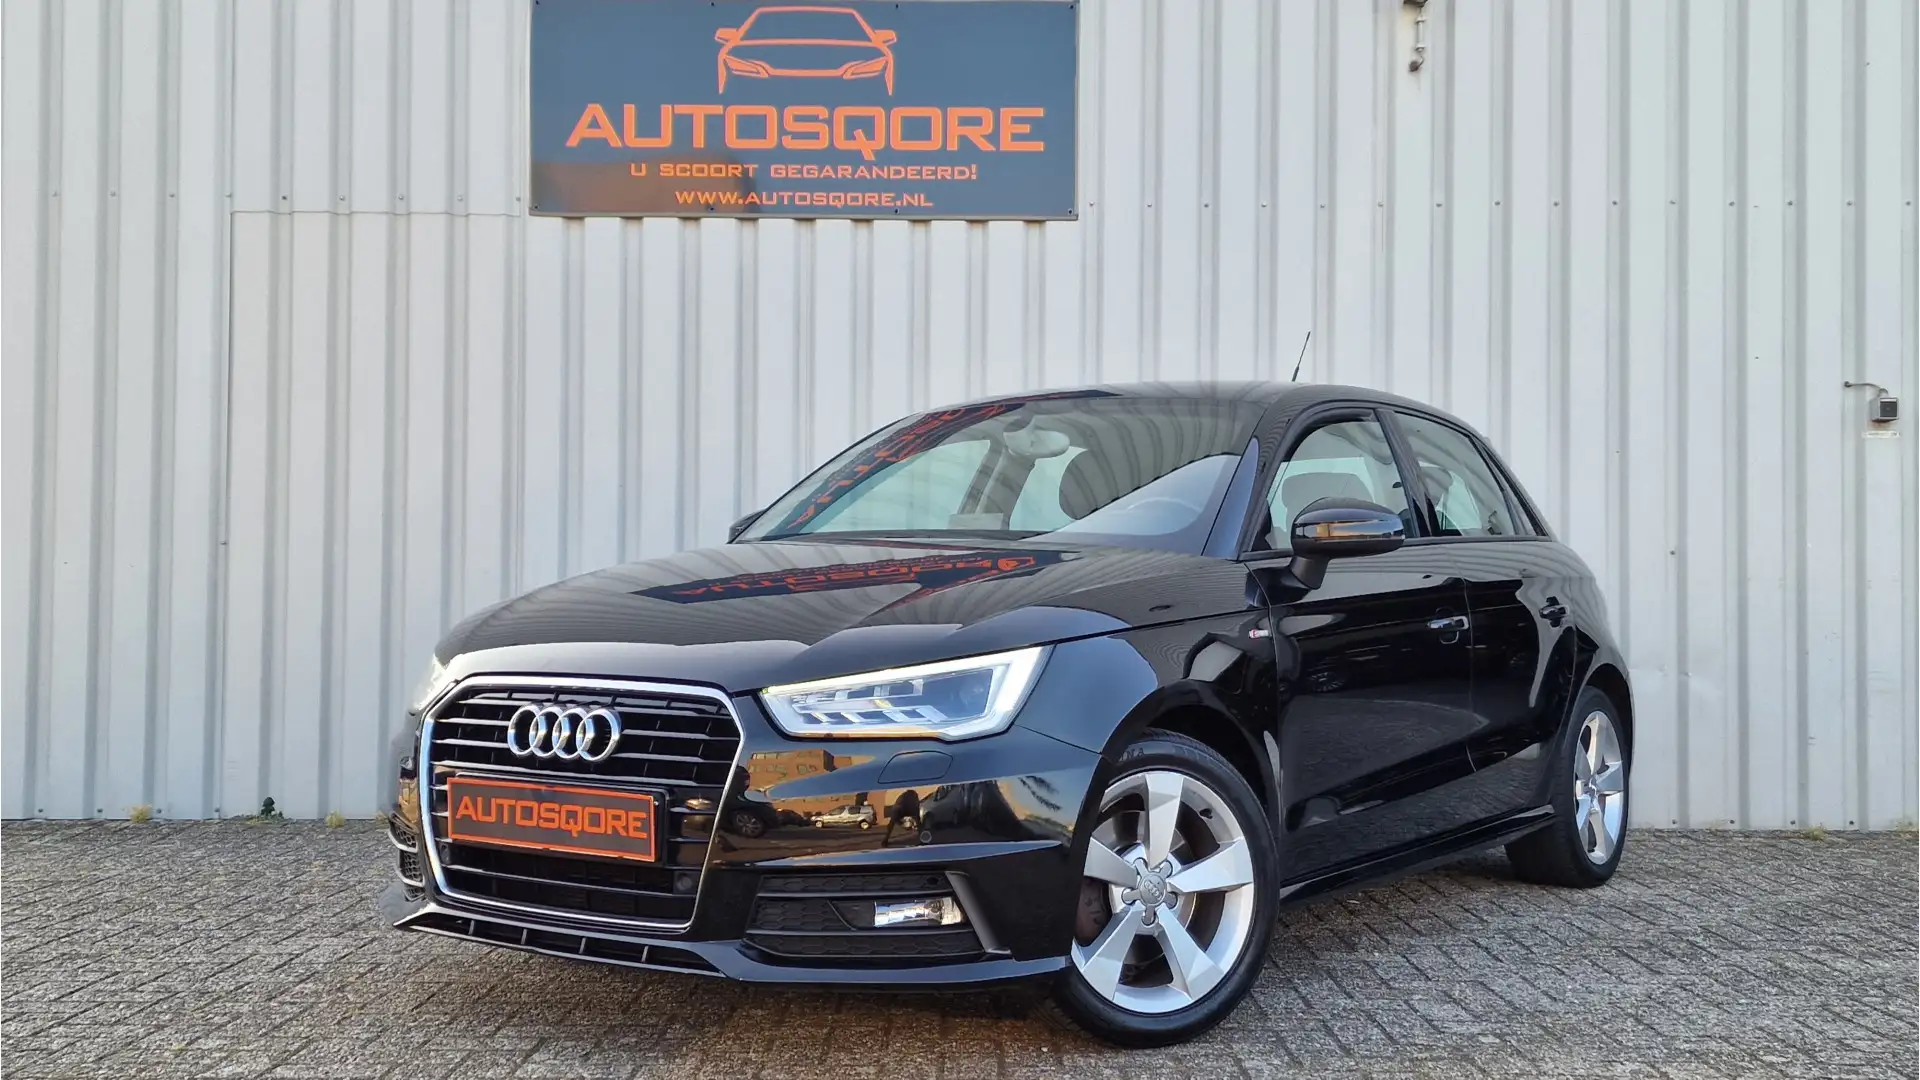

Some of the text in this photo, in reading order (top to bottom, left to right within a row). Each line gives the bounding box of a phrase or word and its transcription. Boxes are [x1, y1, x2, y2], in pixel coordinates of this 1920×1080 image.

[565, 103, 1046, 161] AUTOSQORE
[629, 163, 977, 181] U SCOORT GEGARANDEERD!
[674, 189, 933, 209] WWW.AUTOSQORE.NL
[455, 796, 648, 838] AUTOSQORE
